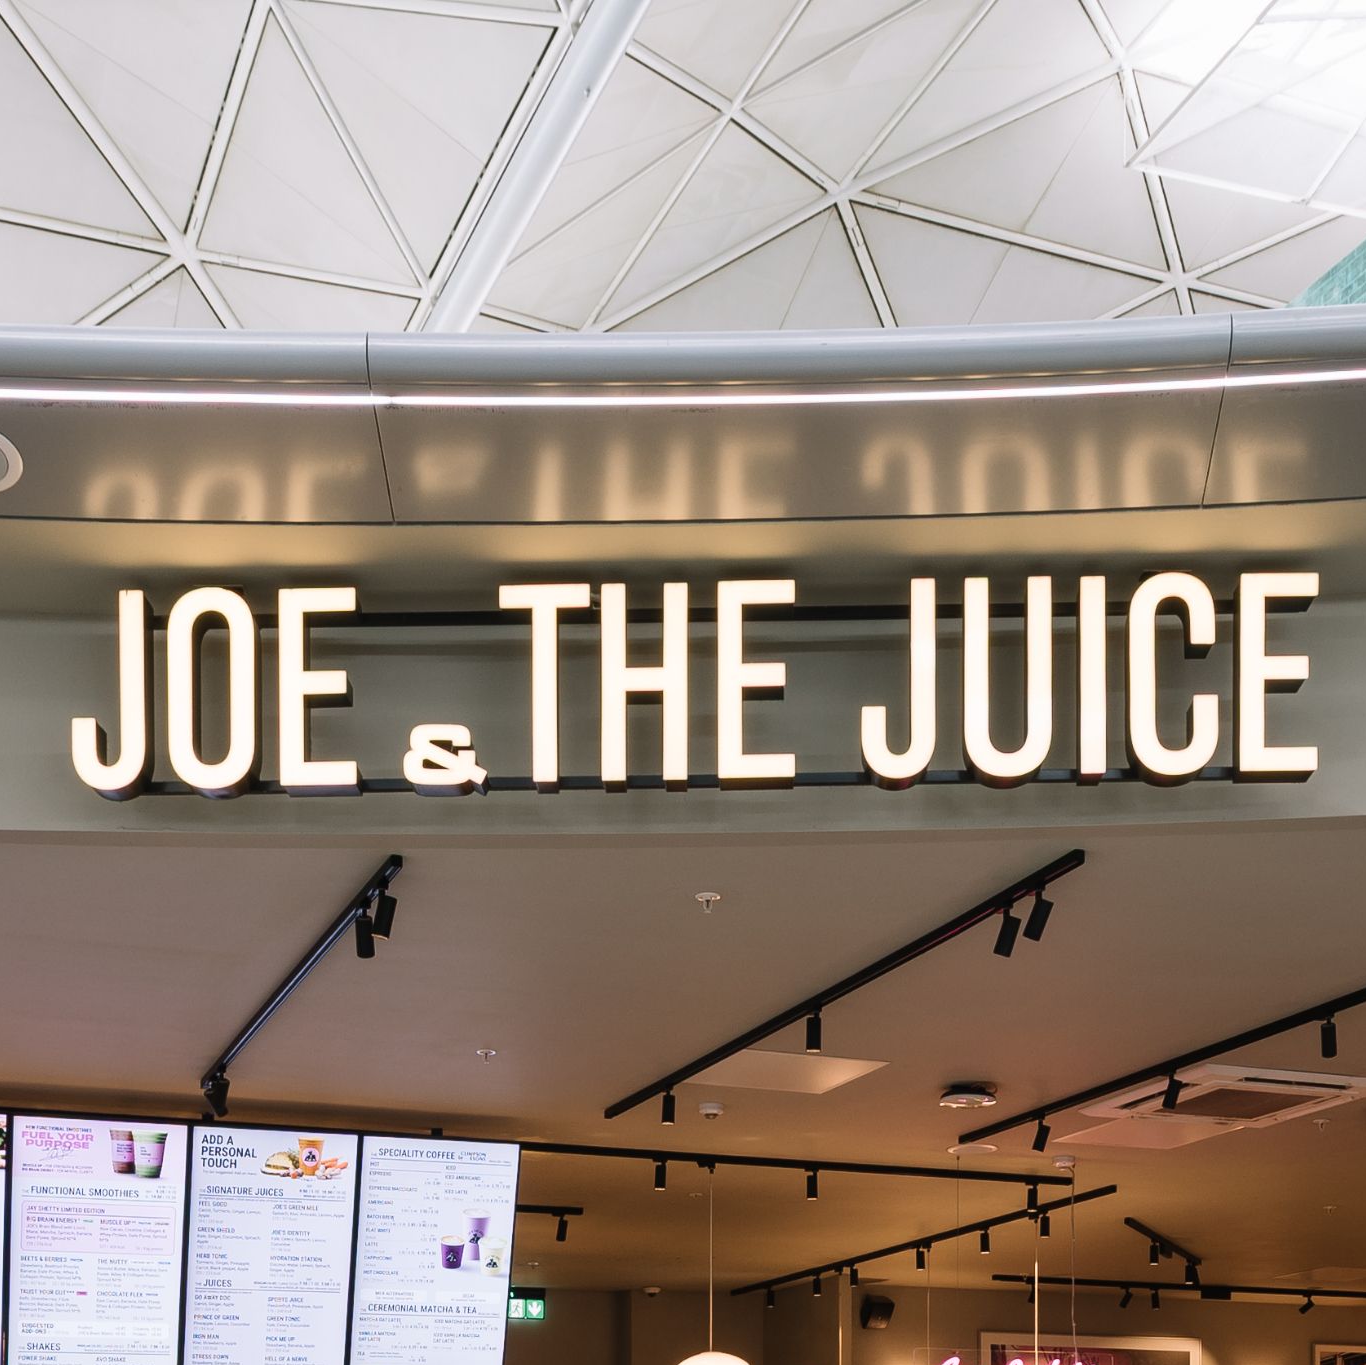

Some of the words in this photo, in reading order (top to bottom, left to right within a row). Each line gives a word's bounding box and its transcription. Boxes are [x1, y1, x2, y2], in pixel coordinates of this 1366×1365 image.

[71, 587, 359, 795] JOE
[403, 723, 487, 790] &
[498, 579, 797, 788] THE
[860, 571, 1321, 786] JUICE
[21, 1131, 54, 1140] FUEL
[58, 1132, 94, 1142] YOUR
[201, 1134, 224, 1145] ADD
[226, 1135, 234, 1146] A
[25, 1139, 90, 1150] PURPOSE
[201, 1146, 257, 1159] PERSONAL
[378, 1148, 424, 1158] SPECIALITY
[426, 1150, 456, 1160] COFFEE
[201, 1158, 237, 1169] TOUCH
[30, 1185, 86, 1197] FUNCTIONAL
[88, 1188, 140, 1199] SMOOTHIES
[206, 1185, 253, 1196] SIGNATURE
[254, 1188, 284, 1197] JUICES
[203, 1279, 232, 1288] JUICES
[367, 1303, 419, 1313] CEREMONIAL
[420, 1305, 454, 1314] MATCHA
[455, 1305, 461, 1314] &
[463, 1306, 477, 1314] TEA
[26, 1343, 61, 1351] SHAKES
